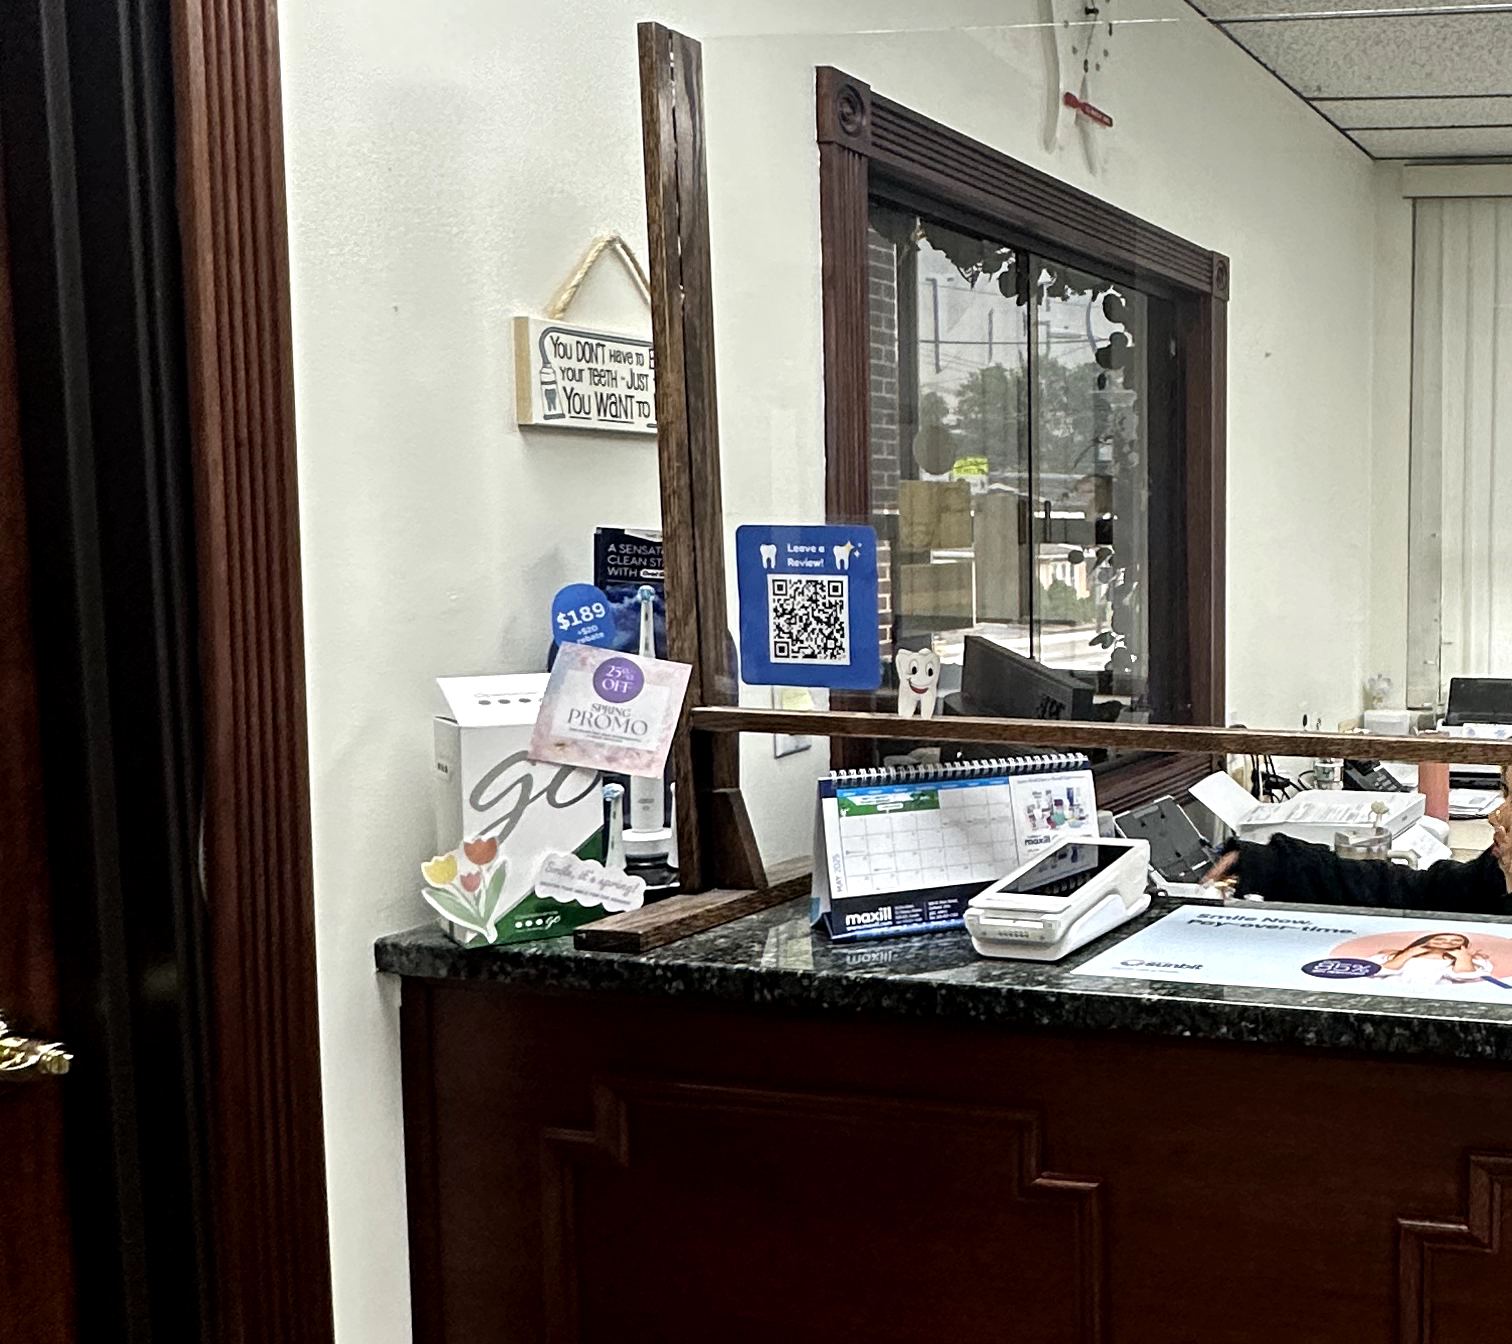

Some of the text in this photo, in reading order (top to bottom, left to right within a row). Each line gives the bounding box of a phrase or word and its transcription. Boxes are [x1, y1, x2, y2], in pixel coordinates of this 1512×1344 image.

[549, 335, 573, 360] You
[607, 543, 617, 553] A
[787, 543, 825, 553] Leave a
[607, 555, 647, 566] CLEAN
[787, 558, 825, 568] Review!
[607, 566, 638, 577] WITH
[556, 603, 606, 631] $189
[602, 679, 633, 693] OFF
[591, 703, 632, 718] SPRING
[567, 708, 648, 736] PROMO
[845, 906, 893, 927] maxill
[1196, 913, 1258, 922] Smile
[1144, 960, 1203, 970] sunbit
